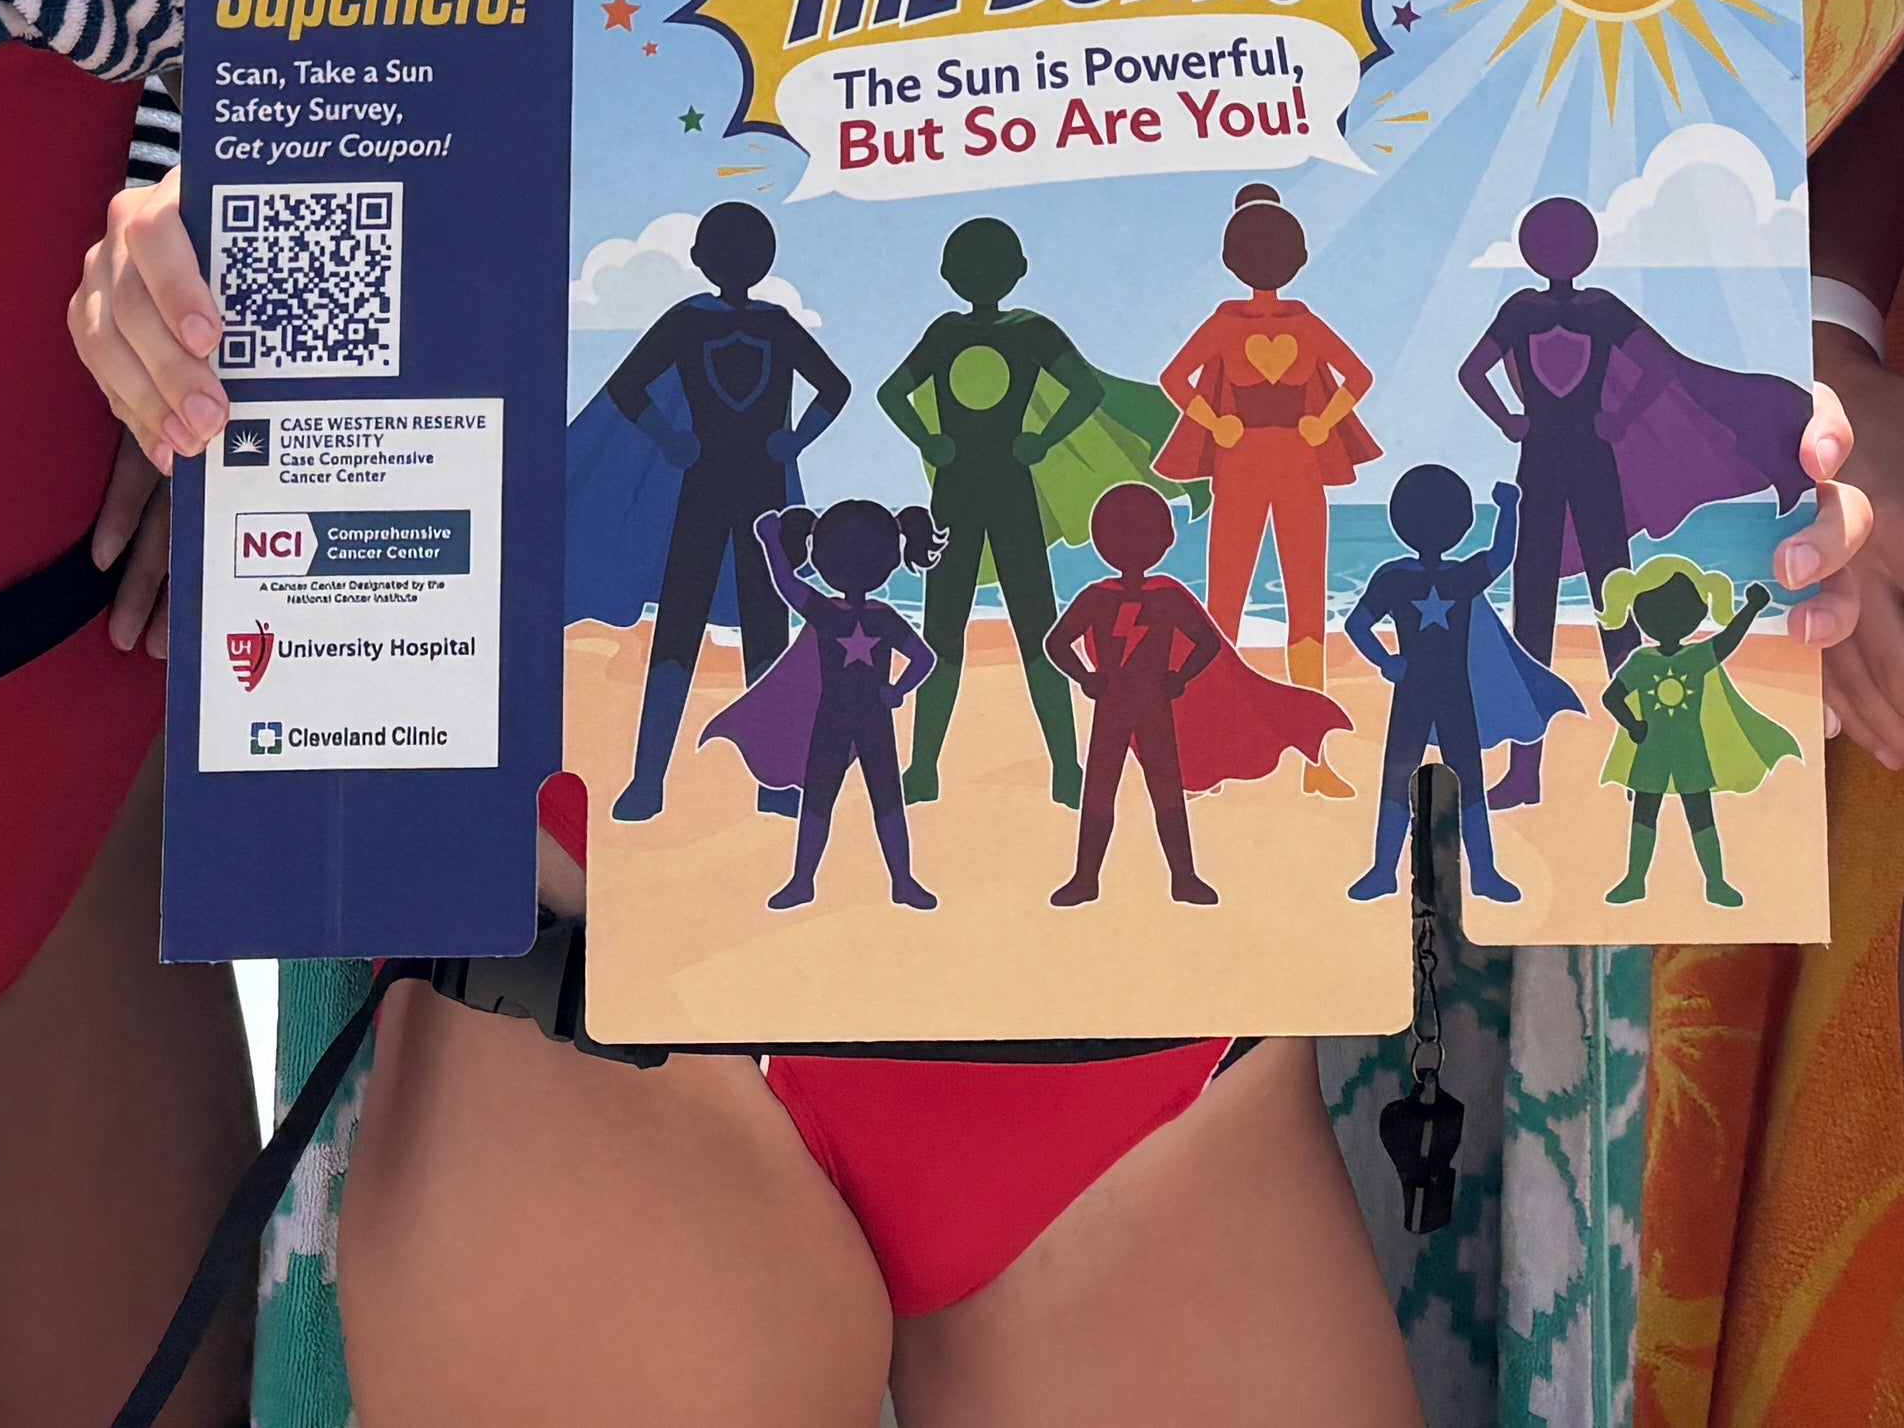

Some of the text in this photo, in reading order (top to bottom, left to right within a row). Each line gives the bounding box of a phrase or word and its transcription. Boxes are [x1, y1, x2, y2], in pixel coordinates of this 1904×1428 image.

[215, 60, 434, 90] Scan, Take a Sun
[833, 37, 1304, 110] The Sun is Powerful,
[215, 98, 404, 127] Safety Survey,
[839, 86, 1310, 170] But So Are You!
[215, 133, 452, 164] Get your Coupon!
[280, 416, 486, 431] CASE WESTERN RESERVE
[280, 434, 384, 448] UNIVERSITY
[280, 452, 434, 468] Case Comprehensive
[280, 469, 386, 483] Cancer Center
[242, 531, 302, 558] NCI
[327, 527, 452, 543] Comprehensive
[327, 546, 440, 560] Cancer Center
[278, 637, 475, 661] University Hospital
[288, 726, 447, 747] Cleveland Clinic
